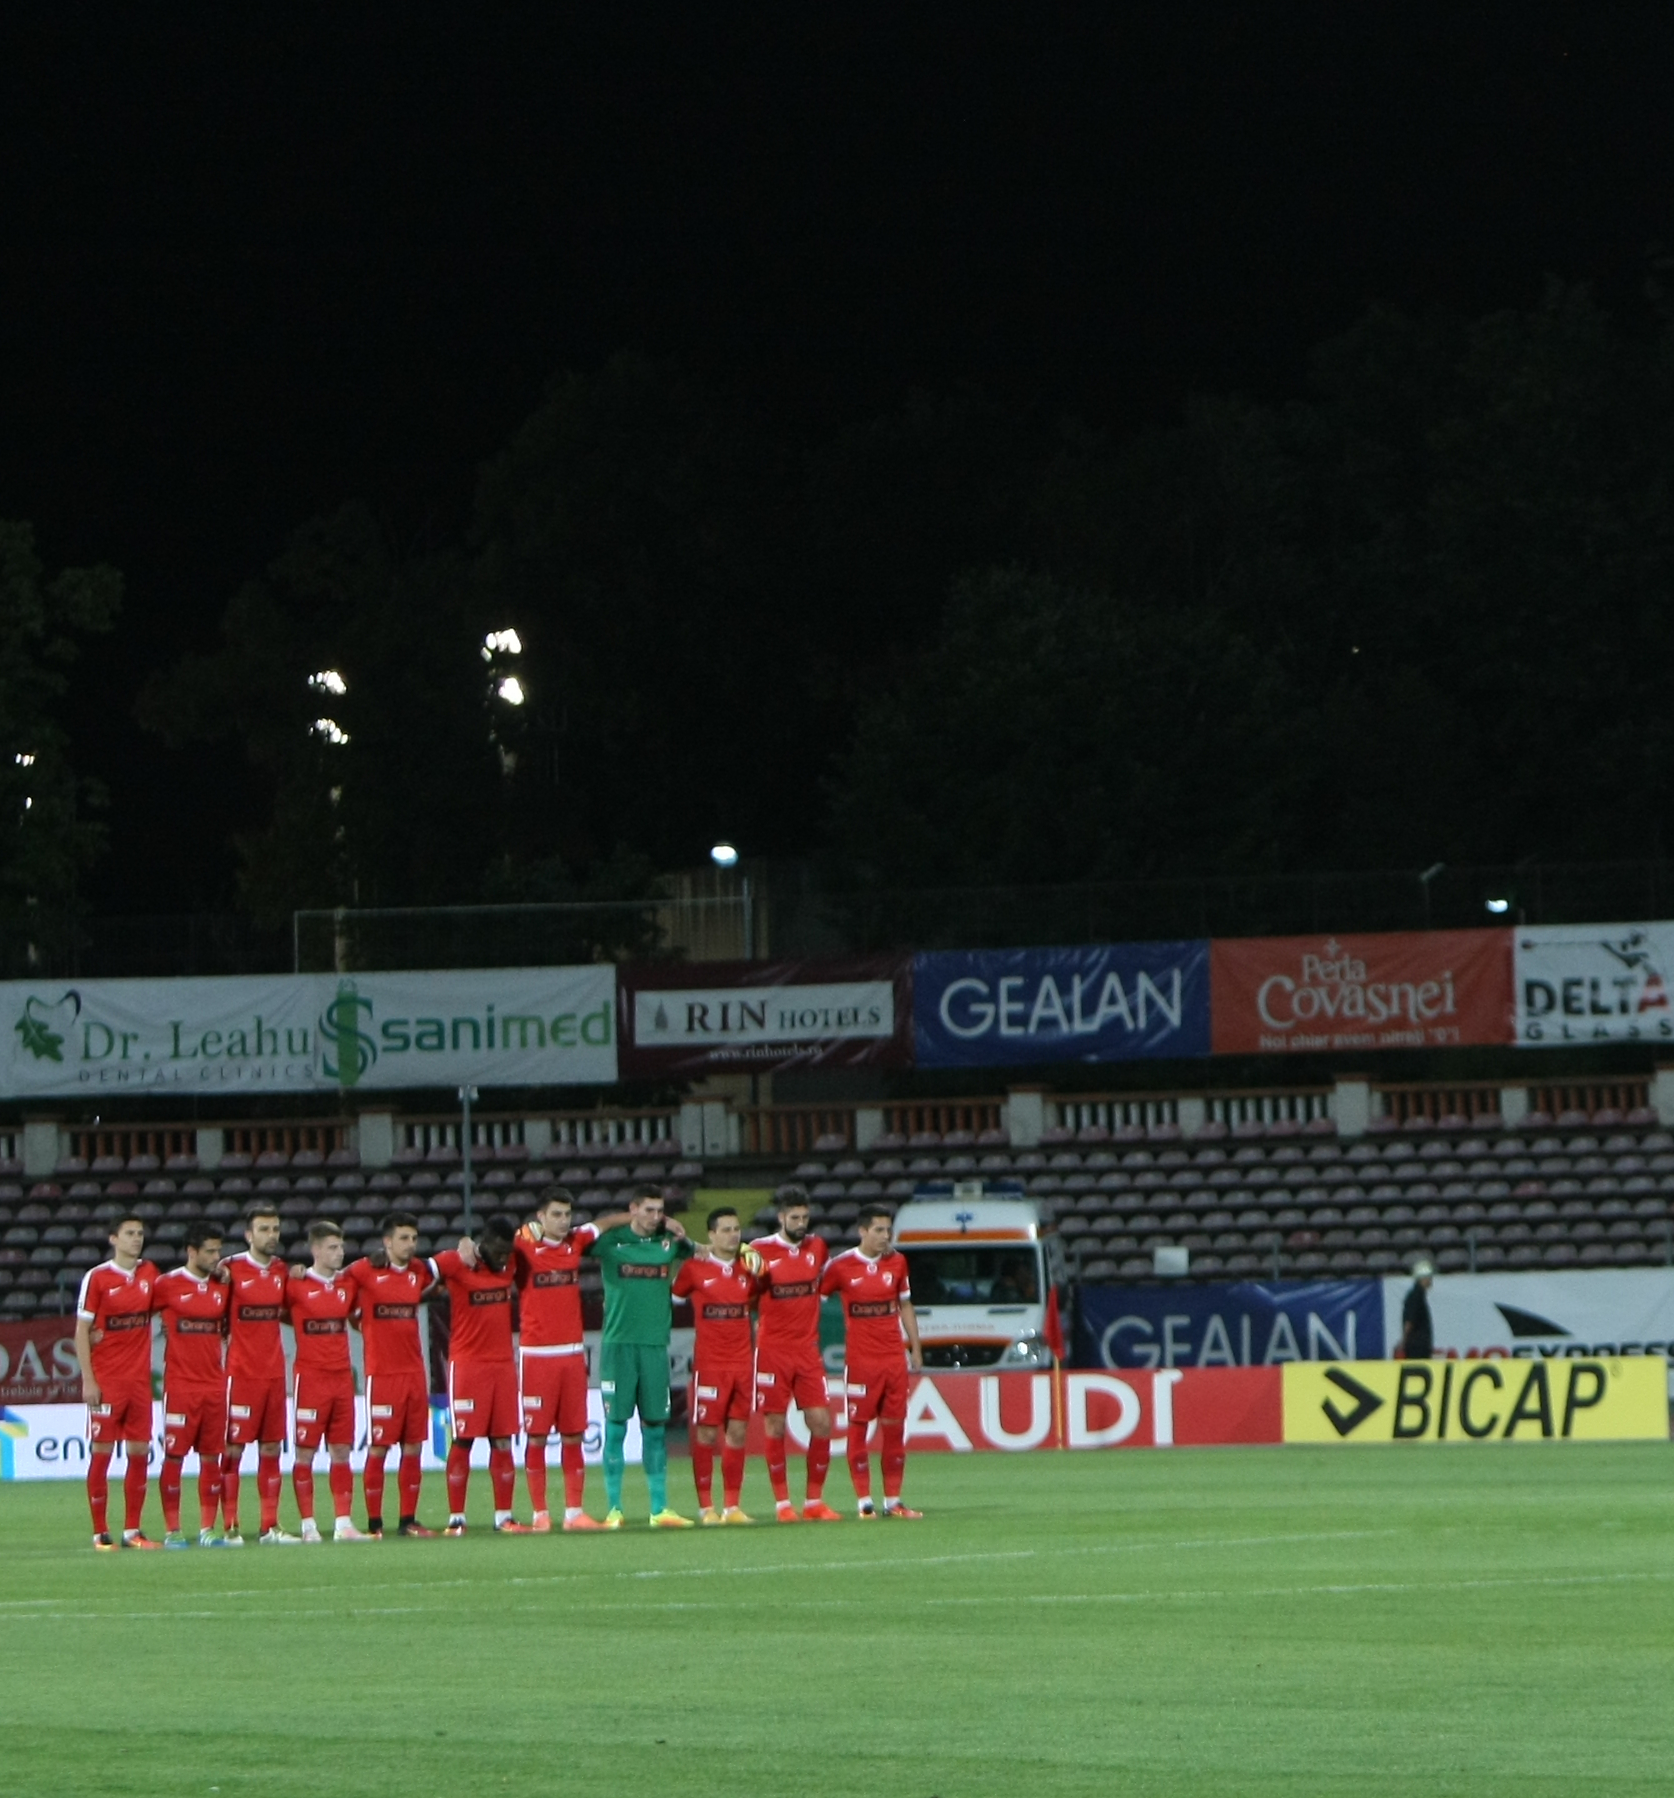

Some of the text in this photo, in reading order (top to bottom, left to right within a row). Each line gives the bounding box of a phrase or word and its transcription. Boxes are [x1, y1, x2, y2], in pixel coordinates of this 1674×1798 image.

[1303, 953, 1368, 980] Perla
[686, 1000, 882, 1033] RIN HOTELS
[939, 968, 1183, 1038] GEALAN
[1256, 970, 1457, 1030] Covasnei
[1524, 974, 1671, 1017] DELTA
[83, 1015, 313, 1061] Dr. Leahu
[382, 1001, 612, 1053] sanimed
[1526, 1017, 1673, 1041] GLASS
[200, 1064, 314, 1081] CLINICS
[1393, 1363, 1607, 1440] BICAP
